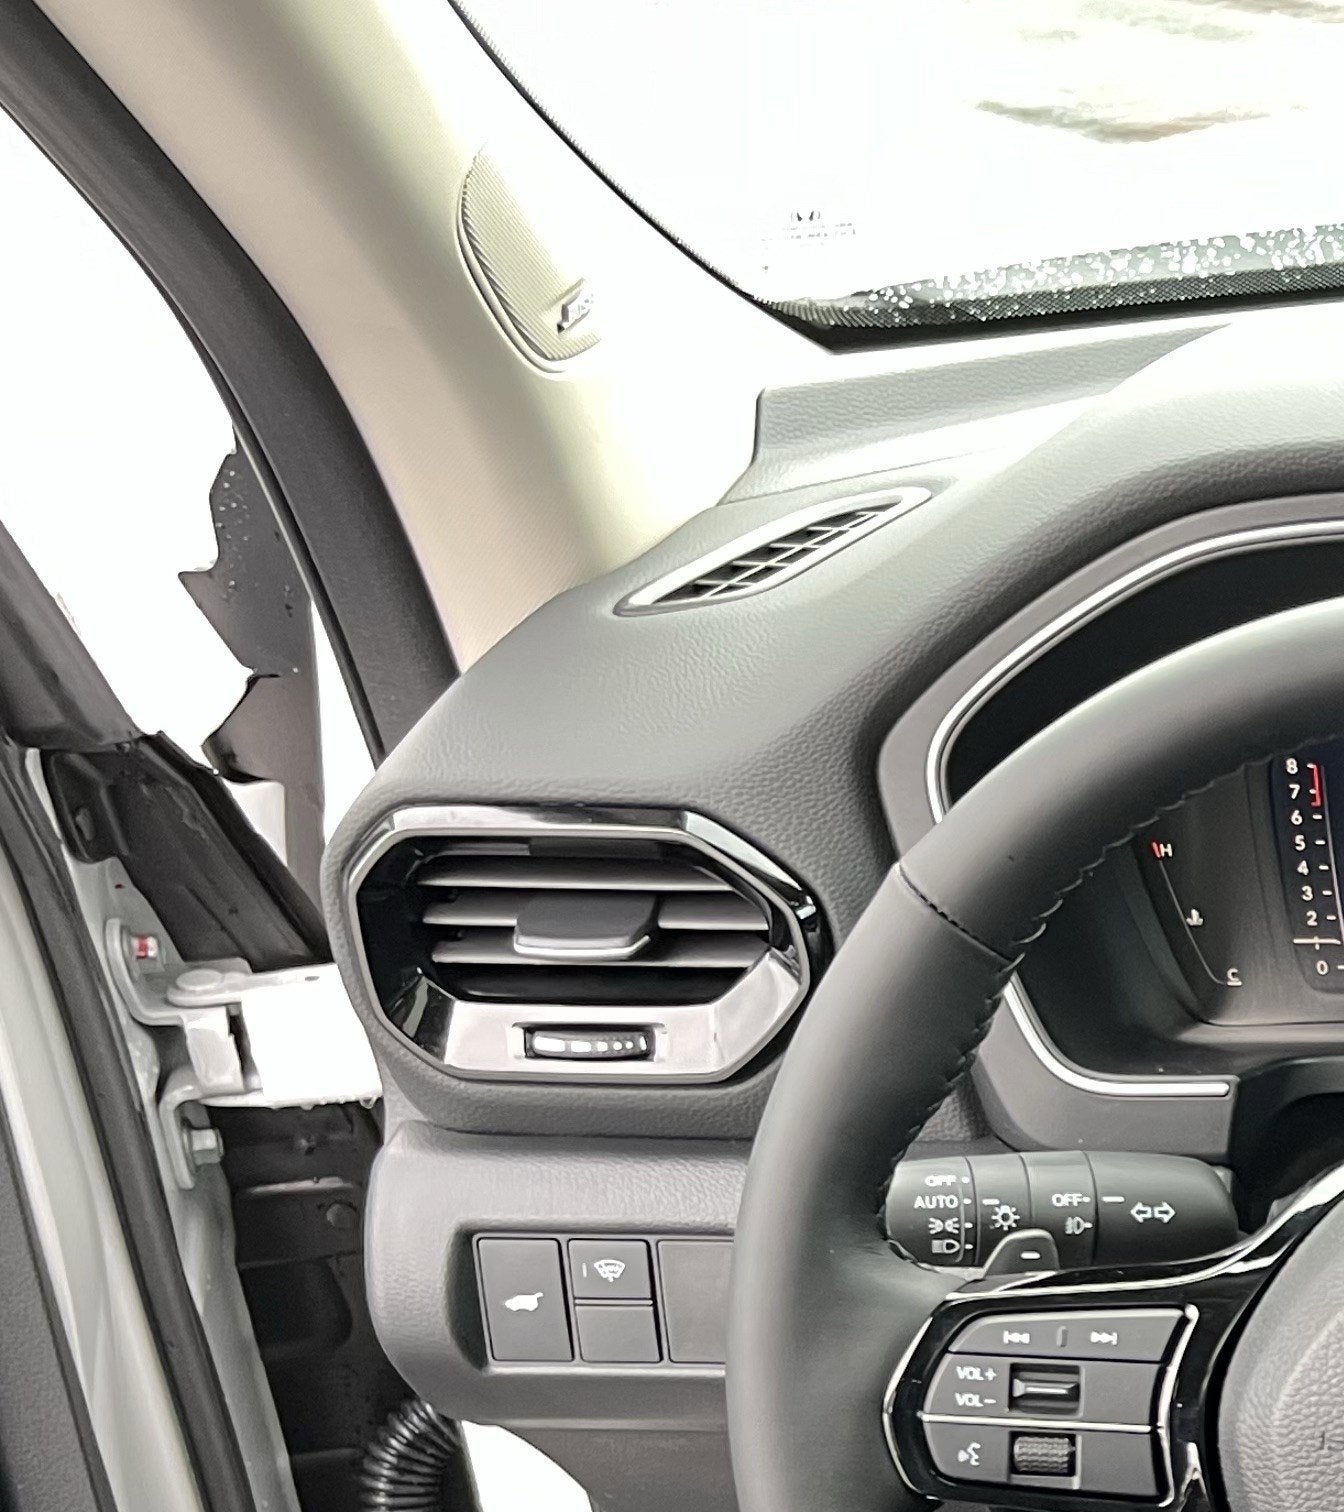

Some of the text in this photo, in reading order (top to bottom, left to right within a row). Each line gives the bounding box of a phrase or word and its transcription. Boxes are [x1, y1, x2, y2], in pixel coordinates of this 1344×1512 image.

[1286, 758, 1297, 774] 8
[1289, 784, 1300, 799] 7
[1291, 809, 1303, 825] 6
[1160, 843, 1173, 857] H
[1295, 835, 1306, 851] 5
[1296, 860, 1309, 876] 4
[1302, 885, 1313, 901] 3
[1306, 910, 1318, 926] 2
[1316, 960, 1328, 975] 0
[925, 1174, 957, 1187] OFF
[914, 1195, 958, 1209] AUTO
[1052, 1193, 1082, 1206] OFF
